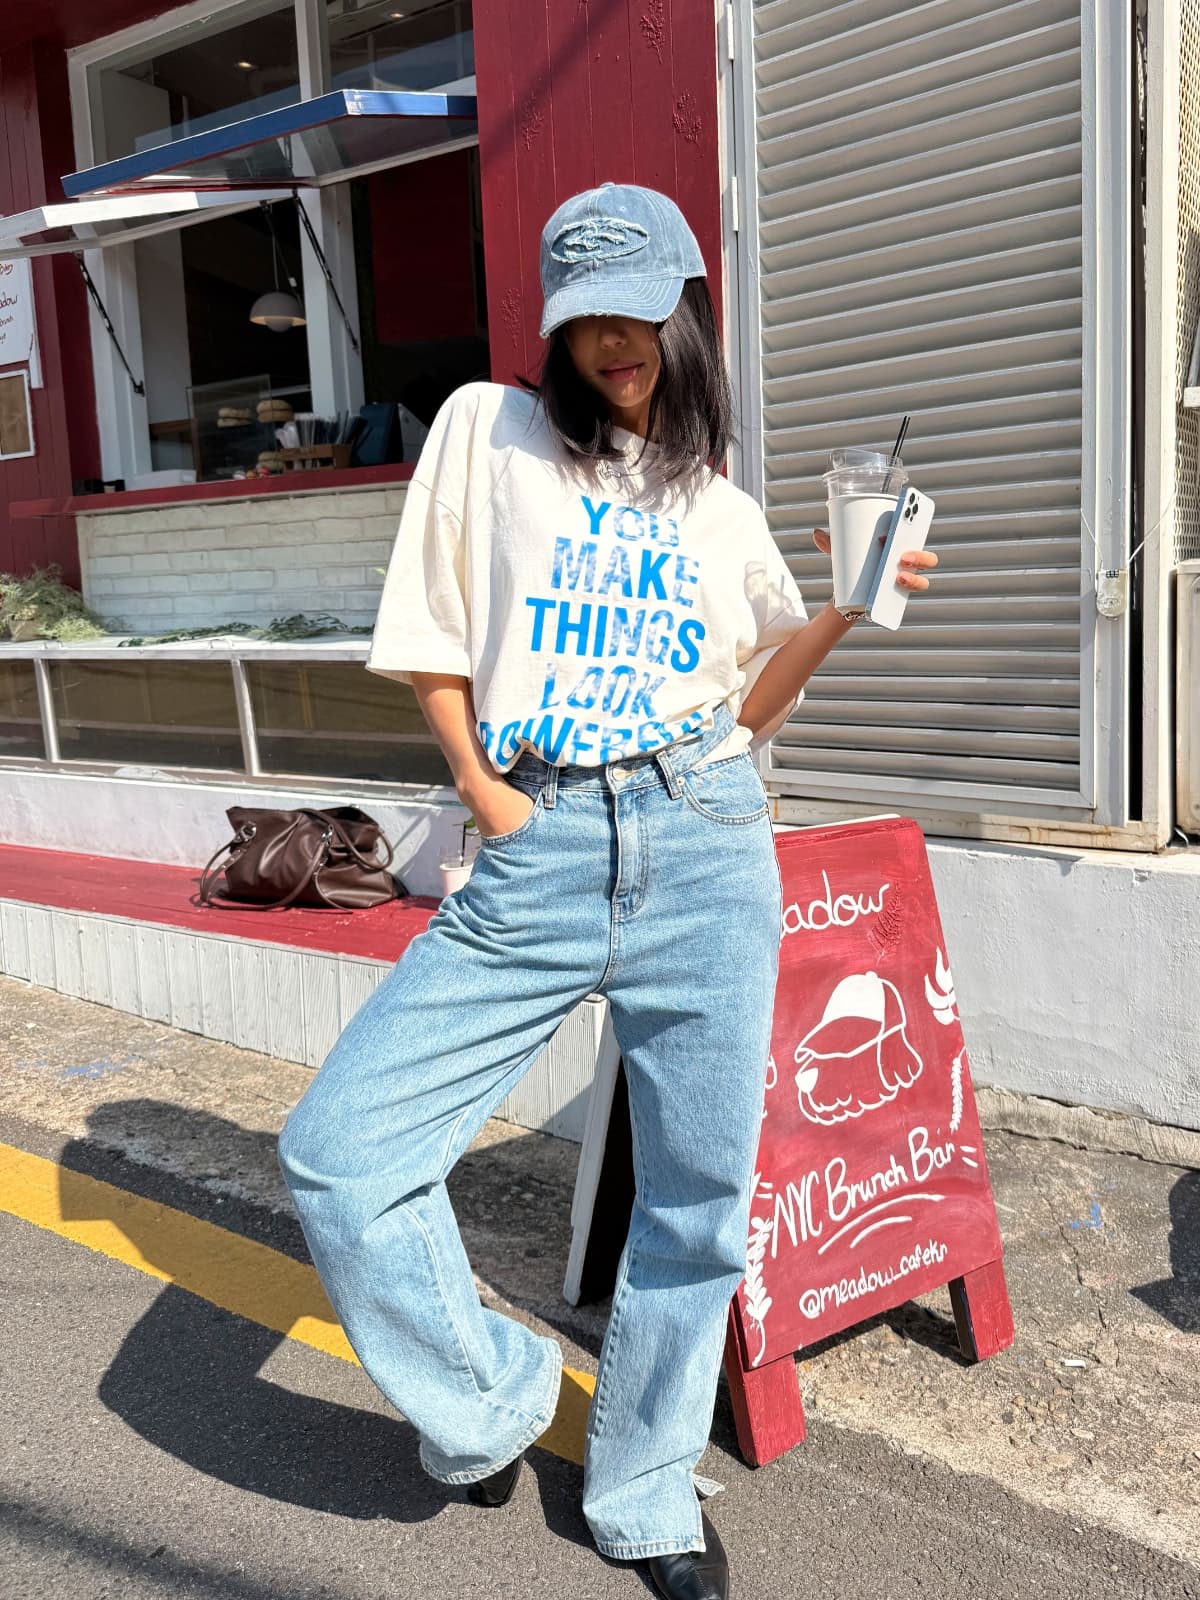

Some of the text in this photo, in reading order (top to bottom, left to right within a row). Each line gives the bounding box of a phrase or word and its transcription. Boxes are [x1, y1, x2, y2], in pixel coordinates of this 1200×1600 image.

[580, 495, 680, 547] YOU
[550, 536, 700, 609] MAKE
[525, 597, 706, 673] THINGS
[537, 662, 666, 720] LOOK
[780, 869, 890, 941] adow
[771, 1126, 955, 1259] NYC Brunch Bar
